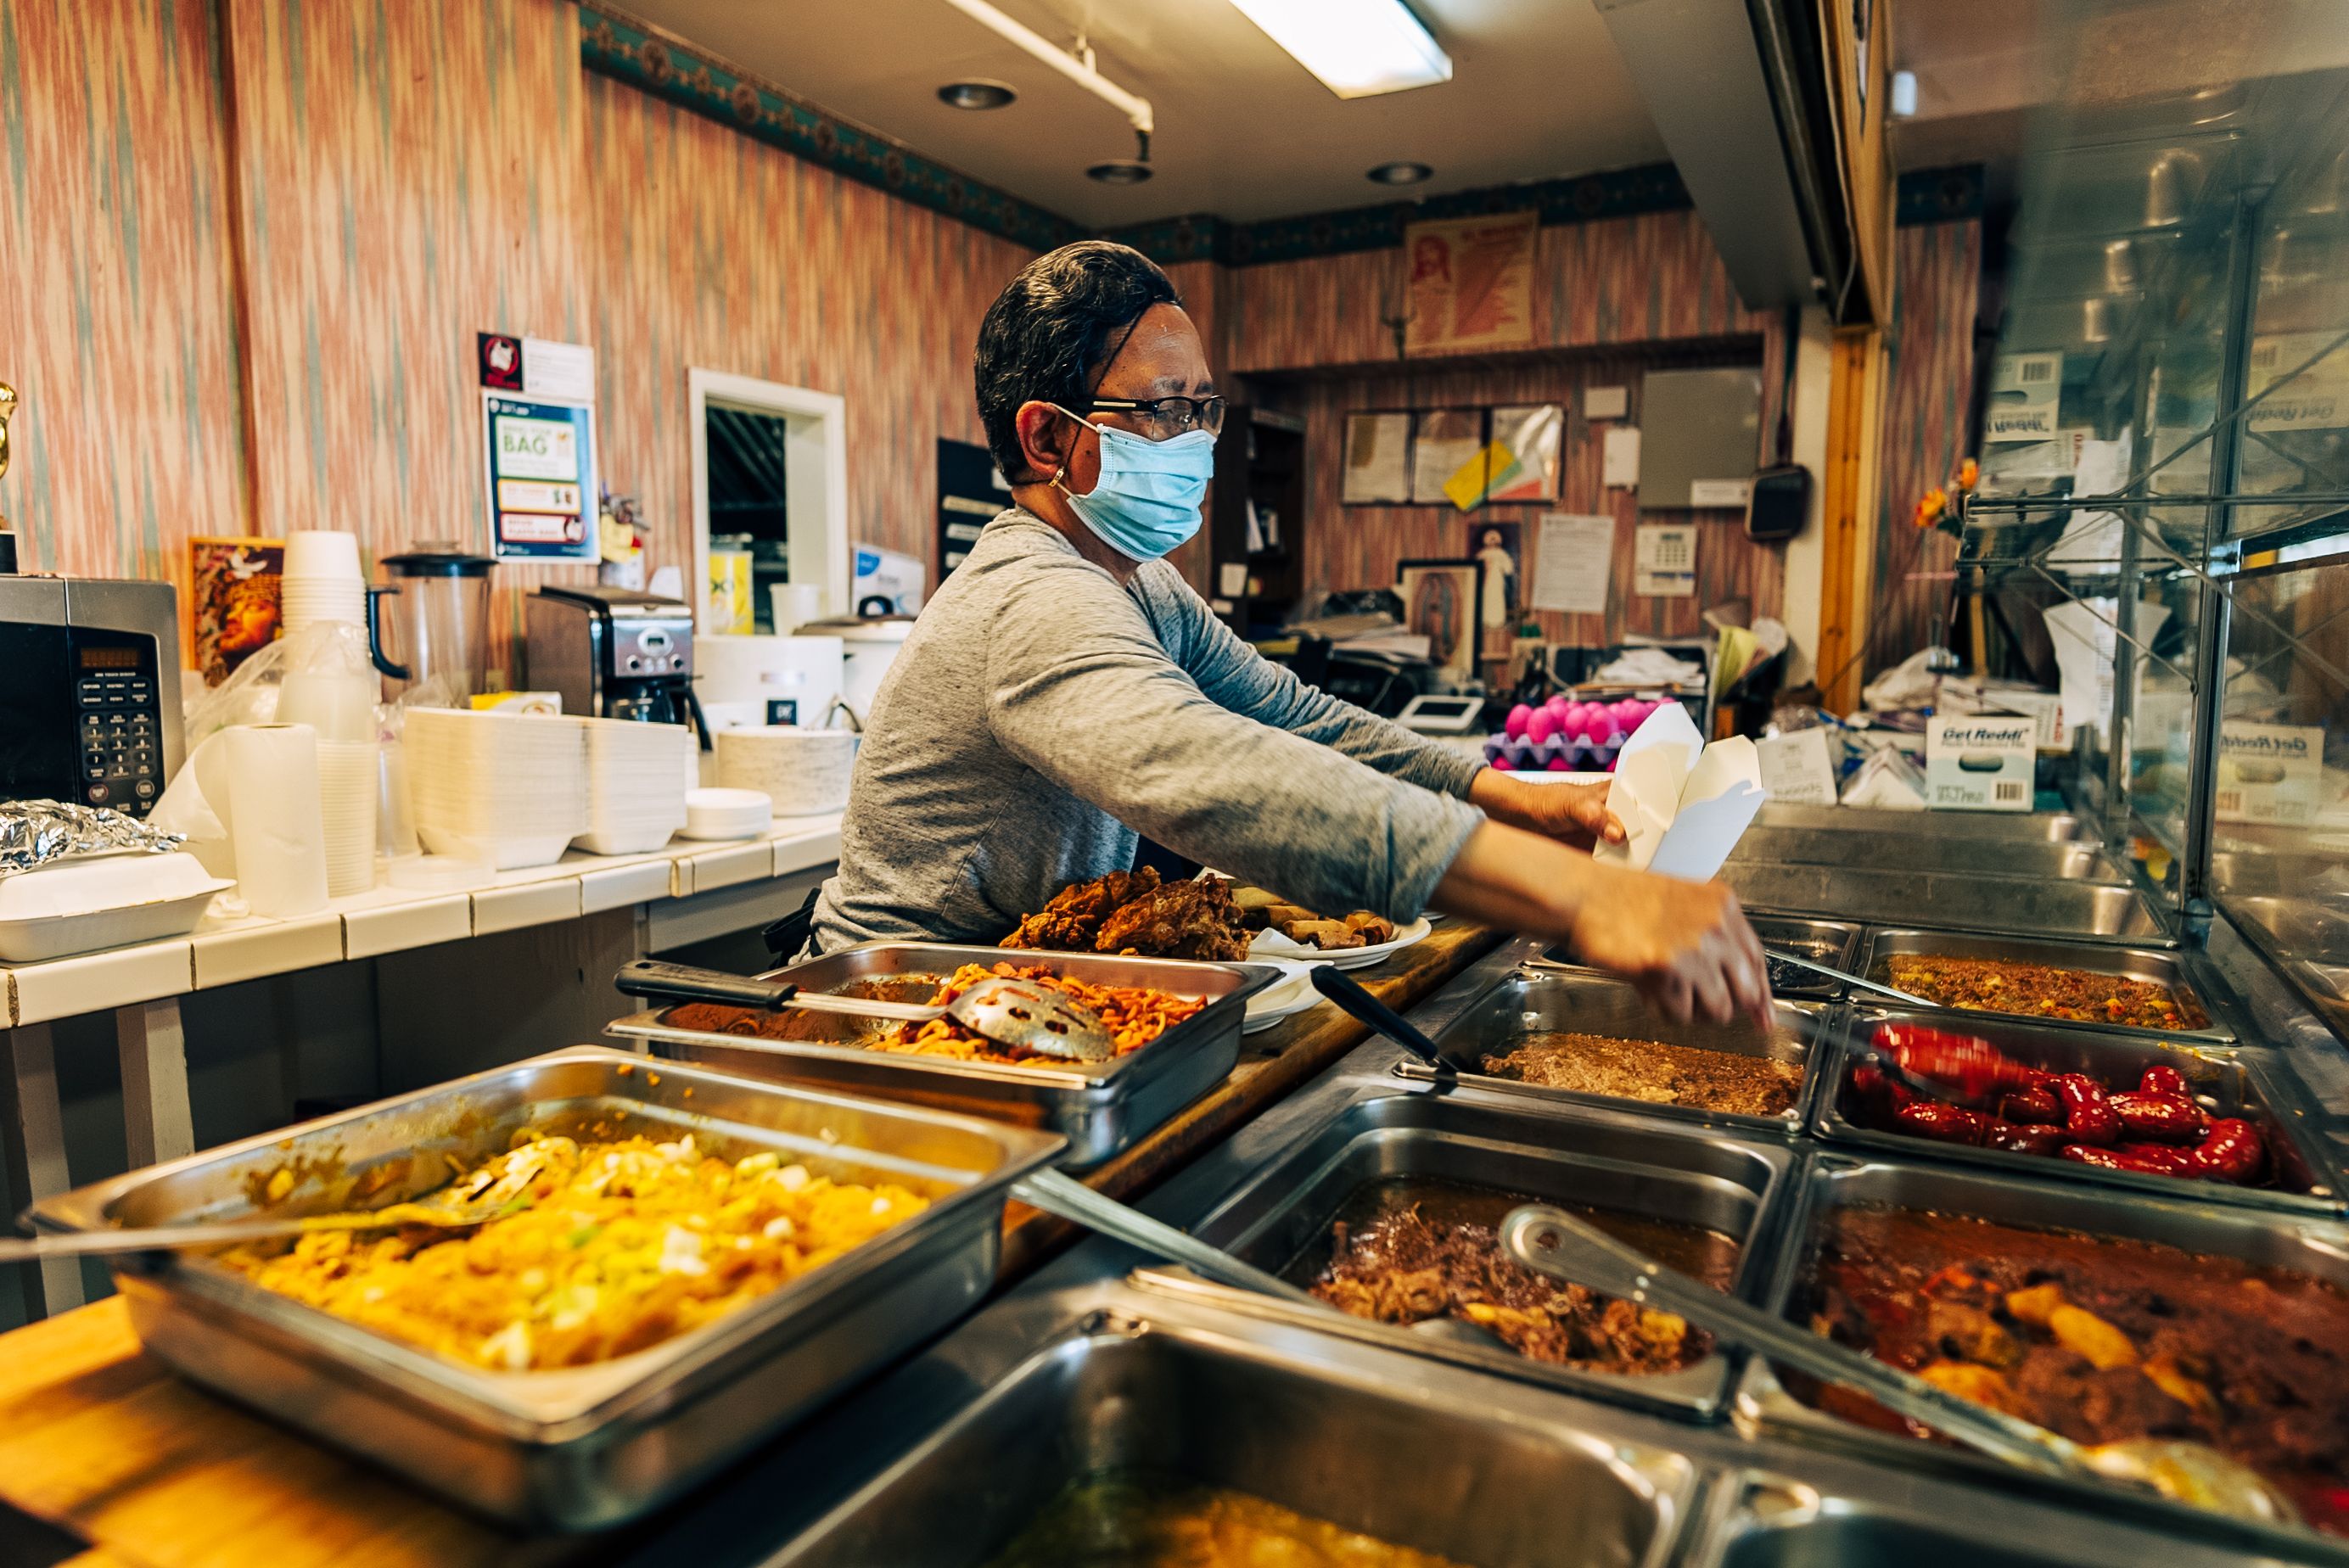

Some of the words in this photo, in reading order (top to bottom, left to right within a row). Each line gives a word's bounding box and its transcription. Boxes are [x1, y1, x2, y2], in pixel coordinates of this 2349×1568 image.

[504, 434, 547, 456] BAG
[1943, 728, 1971, 740] Get
[1974, 726, 2023, 740] Reddi
